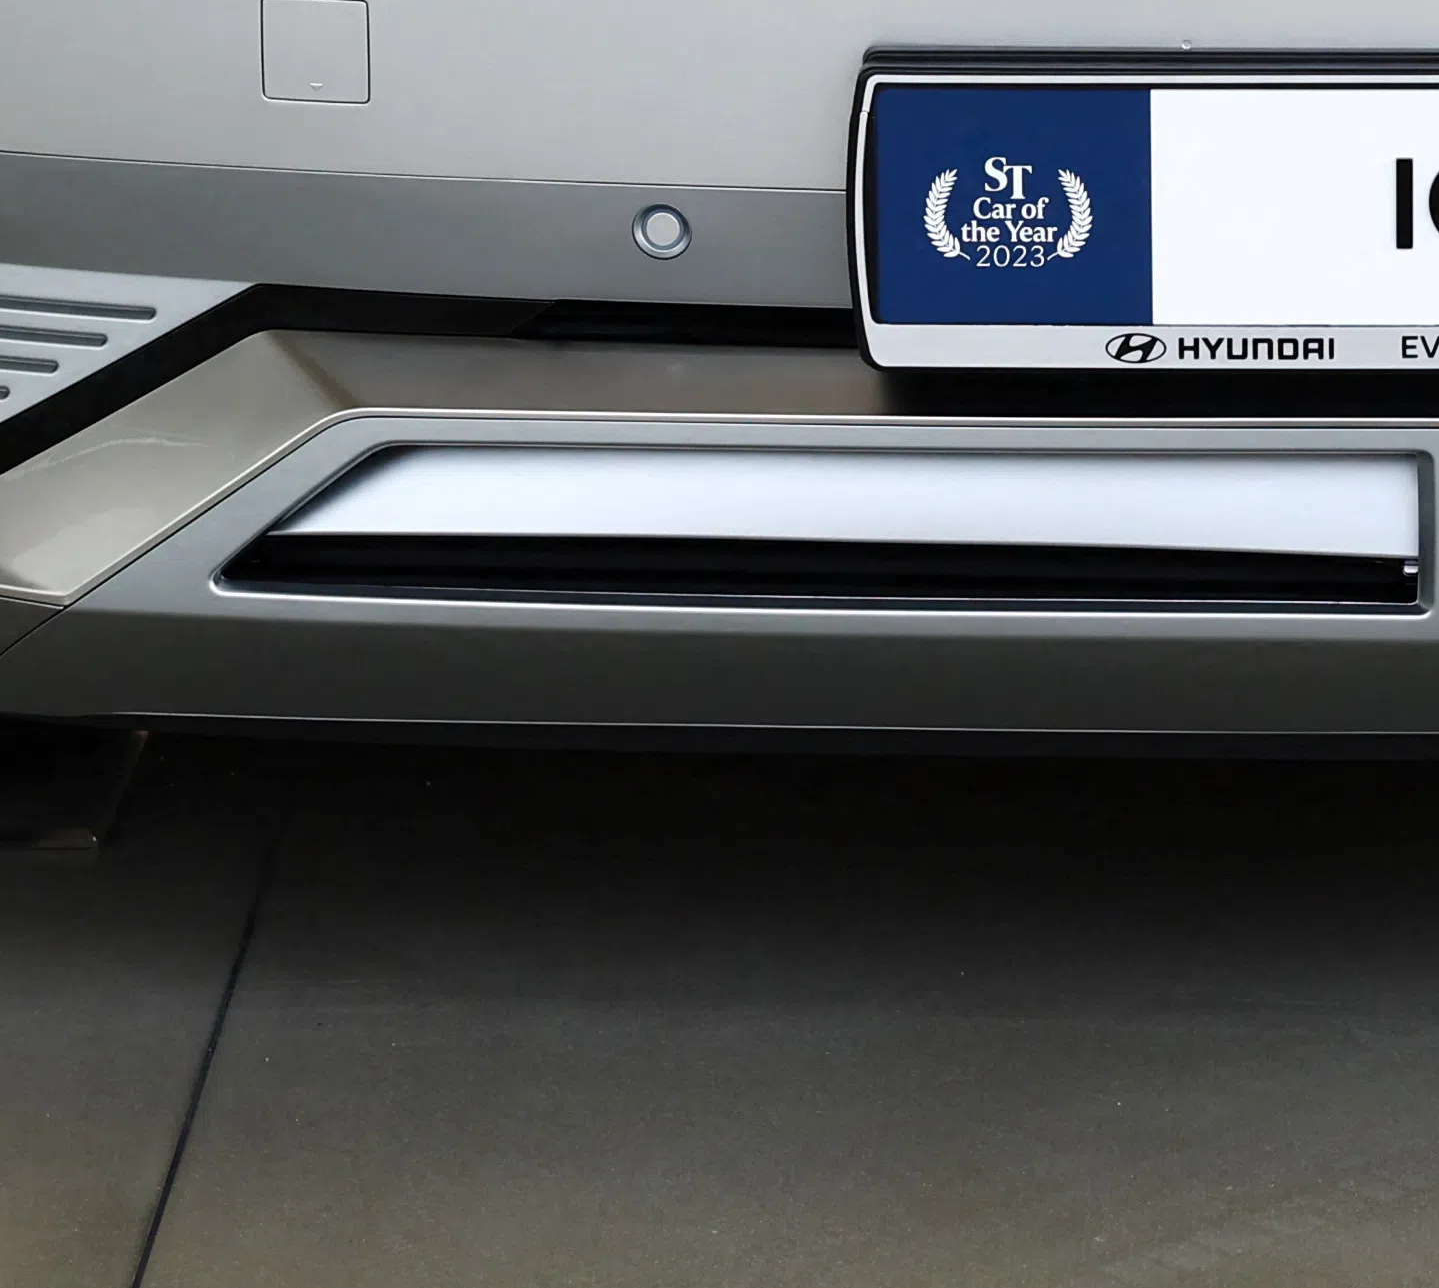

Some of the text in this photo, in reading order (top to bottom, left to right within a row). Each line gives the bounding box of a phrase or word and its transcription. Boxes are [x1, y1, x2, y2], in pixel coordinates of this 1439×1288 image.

[984, 157, 1032, 199] ST
[973, 196, 1050, 219] Car of
[961, 220, 1058, 243] the Year
[977, 245, 1044, 267] 2023
[1179, 338, 1334, 360] HYUNDAI
